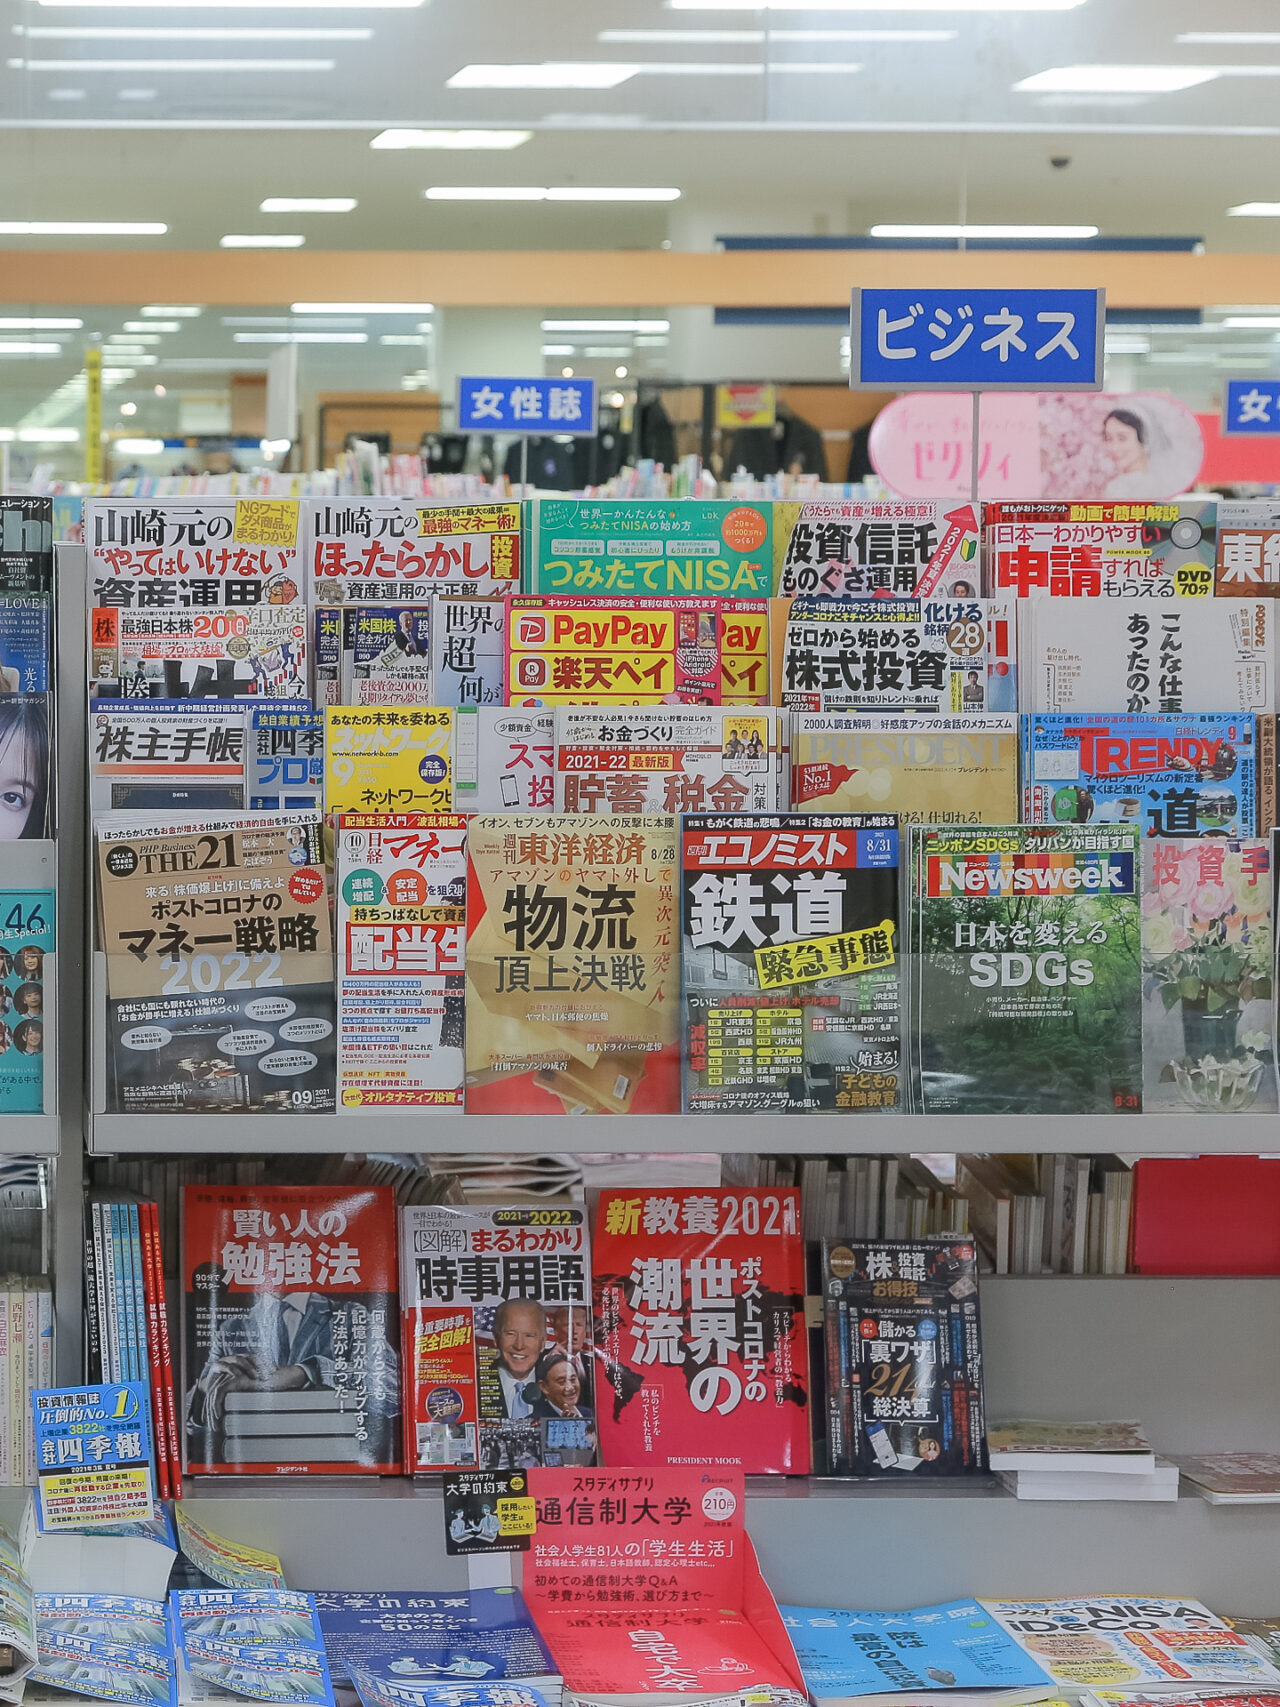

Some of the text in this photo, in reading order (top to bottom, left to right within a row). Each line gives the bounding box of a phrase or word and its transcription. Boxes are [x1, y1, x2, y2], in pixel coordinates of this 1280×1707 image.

[877, 304, 1080, 363] ビジネス
[470, 386, 583, 420] 女性誌
[1237, 391, 1280, 420] 女
[240, 502, 295, 517] NGワードで
[579, 509, 667, 519] 世界一かんたんな
[1070, 505, 1179, 521] 動画で簡単解説
[94, 505, 232, 547] 山崎元の
[241, 515, 292, 530] ダメ商品が
[314, 505, 418, 539] 山崎元の
[422, 516, 517, 535] 最強のマネー術!
[579, 520, 692, 531] つみたてNISAの始め方
[236, 527, 295, 542] まるわかり!
[786, 522, 938, 566] 投資信託
[997, 525, 1161, 543] 日本一わかりやすい
[314, 536, 513, 579] ほったらかし 投資
[1104, 557, 1165, 577] すれば
[782, 566, 919, 592] ものぐさ運用
[998, 545, 1103, 598] 申請
[1177, 570, 1212, 583] DVD
[94, 578, 262, 607] 資産運用
[347, 583, 478, 600] 資産運用の大正解
[1103, 579, 1174, 598] もらえる
[1179, 583, 1209, 596] 70分
[548, 599, 717, 609] キャッシュレス決済の安全・便利な使い方教えます
[791, 602, 919, 612] ビギナーも即戦力で今こそ株式投資!
[924, 603, 983, 623] 化ける
[358, 618, 396, 634] 米国株
[790, 612, 921, 622] アンダーコロナこそチャンスと心得よ!!
[1254, 604, 1265, 647] POPEYE
[357, 634, 395, 646] 完全ガイド
[554, 615, 667, 647] PayPay
[788, 628, 921, 649] ゼロから始める
[924, 621, 980, 647] 銘柄 28
[553, 657, 668, 689] 楽天ペイ
[787, 649, 947, 692] 株式投資
[1158, 613, 1183, 713] こんな仕事
[331, 712, 451, 726] あなたの未来を委ねる
[500, 723, 532, 733] 少額資金
[598, 726, 673, 742] お金づくり
[1175, 727, 1224, 735] 日経トレンディ
[91, 727, 243, 763] 株主手帳
[810, 736, 1008, 766] PRESIDENT
[566, 755, 627, 769] 2021-22
[631, 755, 671, 769] 最新版
[1083, 773, 1203, 784] マイクロツーリズムの新定番
[478, 816, 675, 829] イオン、セブンもアマゾンへの反撃に本腰
[517, 833, 646, 865] 東洋経済
[699, 833, 847, 865] エコノミスト
[866, 840, 891, 852] 8/31
[927, 838, 1019, 852] ニッポンSDGs
[1025, 836, 1134, 851] タリバンが目指す国
[651, 848, 675, 860] 8/28
[939, 858, 1125, 891] Newsweek
[151, 893, 282, 920] ポストコロナの
[688, 872, 847, 949] 鉄道
[502, 884, 637, 952] 物流
[118, 913, 319, 964] マネー戦略
[955, 921, 1108, 947] 日本を変える
[760, 929, 894, 984] 緊急事態
[160, 952, 284, 995] 2022
[494, 955, 647, 993] 頂上決戦
[969, 951, 1094, 987] SDGs
[365, 1091, 456, 1104] オルタナティブ投資
[233, 1208, 348, 1240] 賢い人の
[471, 1228, 583, 1253] まるわかり
[221, 1241, 361, 1287] 勉強法
[419, 1255, 585, 1302] 時事用語
[37, 1392, 100, 1410] 投資情報誌
[573, 1477, 655, 1492] スタディサプリ
[535, 1498, 693, 1526] 通信制大学
[703, 1498, 735, 1511] 210円
[535, 1540, 734, 1558] 社会人学生81人の「学生生活」
[535, 1575, 678, 1587] 初めての通信制大学Q&A
[1007, 1620, 1161, 1633] iDeCo
